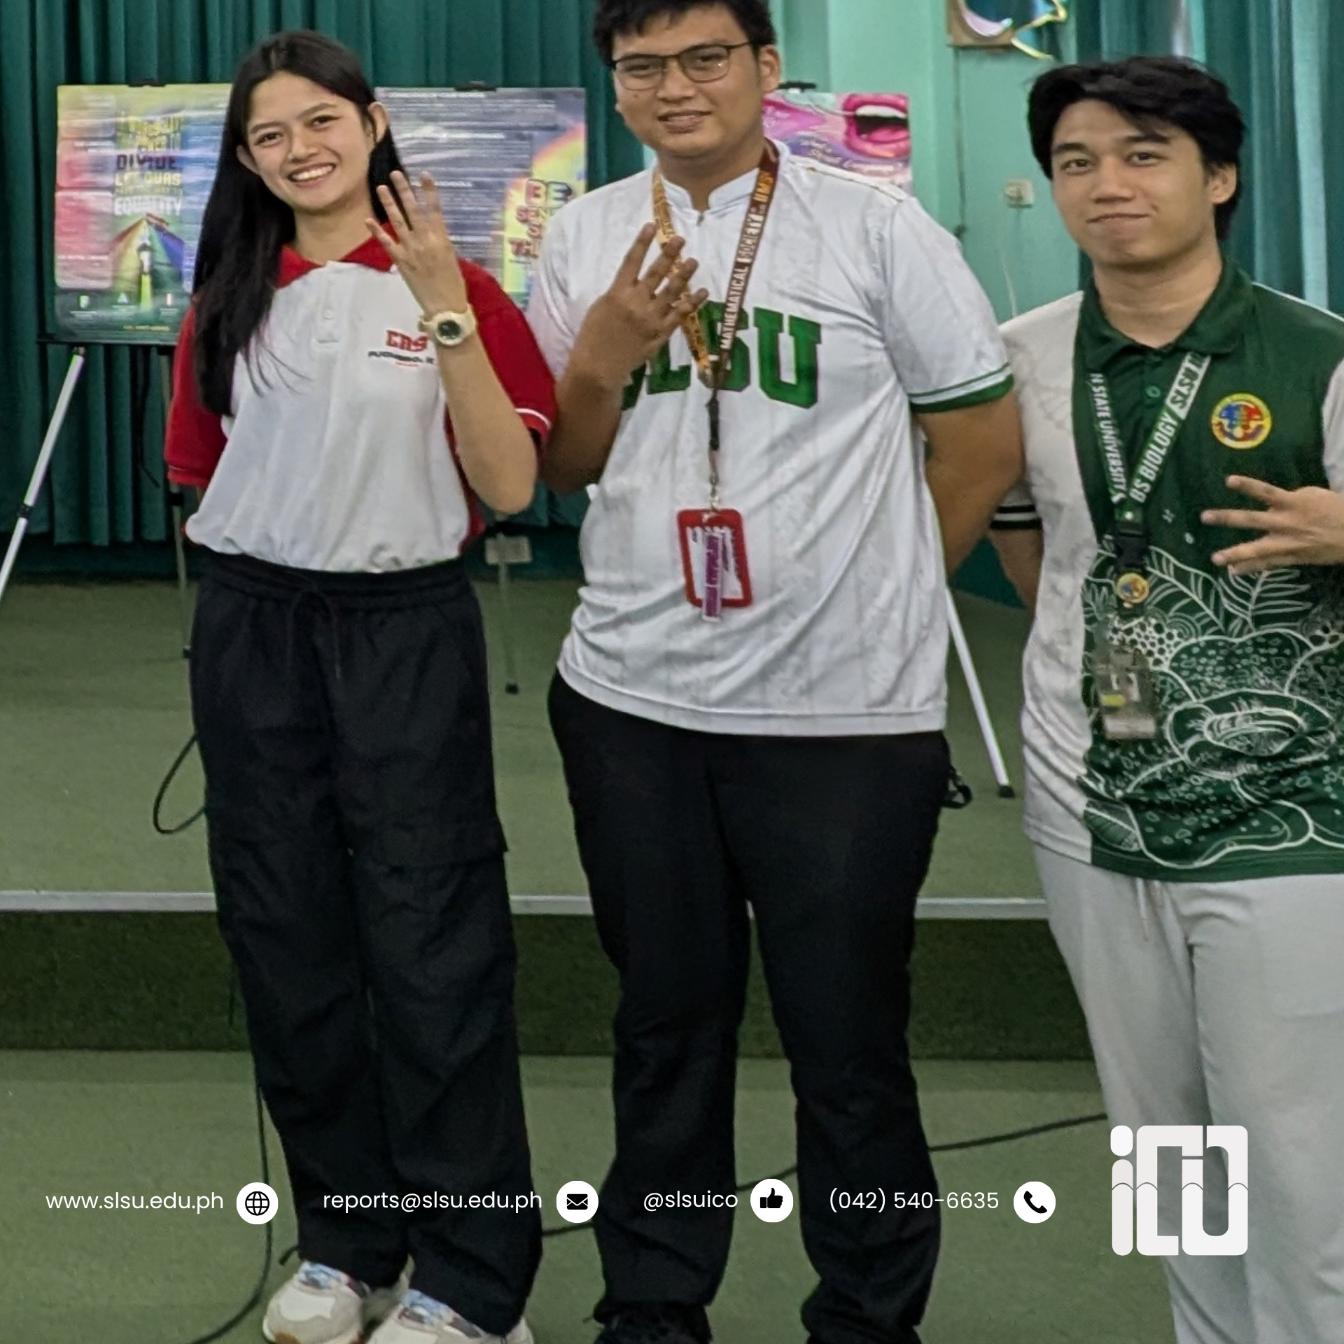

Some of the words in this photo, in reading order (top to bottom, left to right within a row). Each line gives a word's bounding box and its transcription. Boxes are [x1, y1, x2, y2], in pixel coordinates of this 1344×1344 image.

[720, 265, 749, 350] MATHEMATICAL
[1091, 384, 1111, 417] STATE
[1100, 418, 1127, 493] UNIVERSITY
[1128, 481, 1152, 504] BS
[1144, 412, 1179, 480] BIOLOGY
